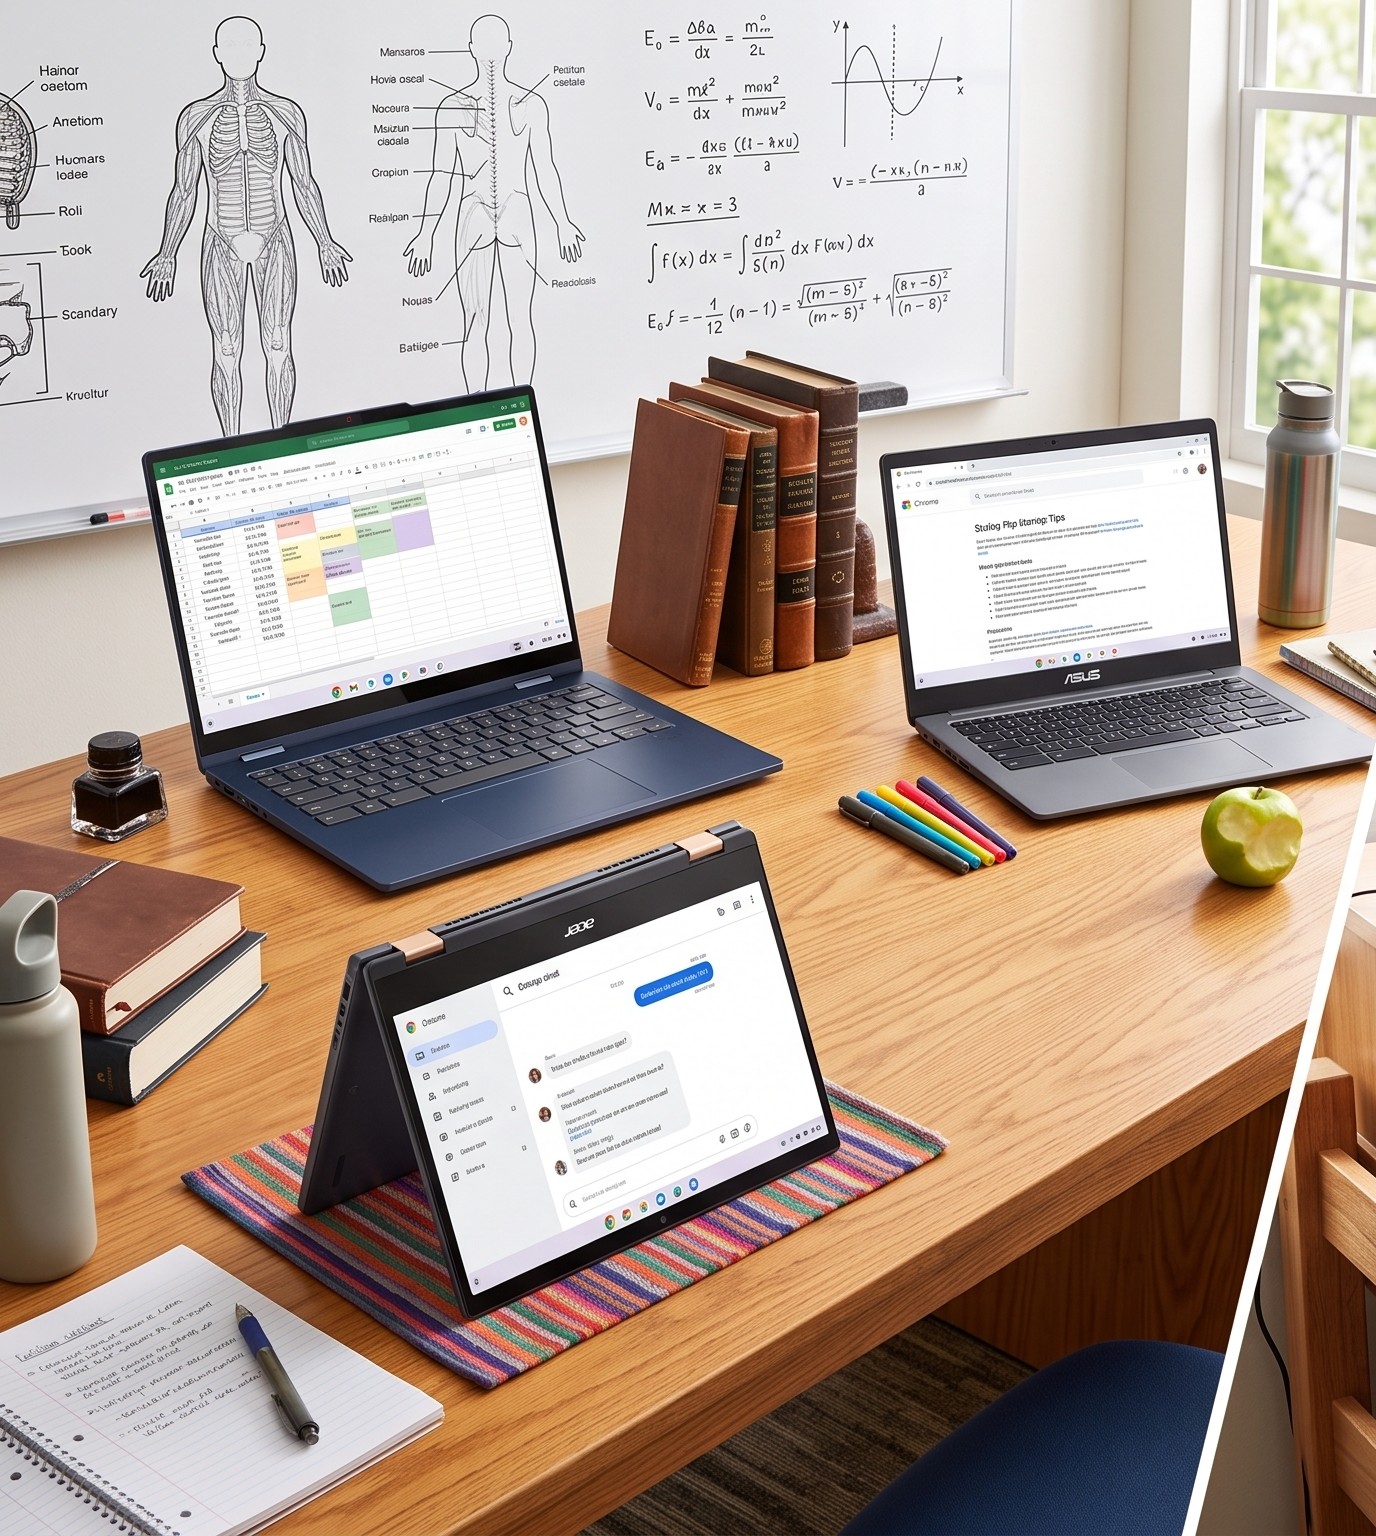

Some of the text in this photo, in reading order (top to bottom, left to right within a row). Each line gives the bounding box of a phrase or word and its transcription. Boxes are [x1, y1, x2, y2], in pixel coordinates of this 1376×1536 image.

[729, 197, 737, 211] 3
[62, 307, 117, 320] Scandary
[1048, 514, 1065, 523] Tips
[1064, 669, 1100, 684] ASUS
[564, 918, 595, 938] acer
